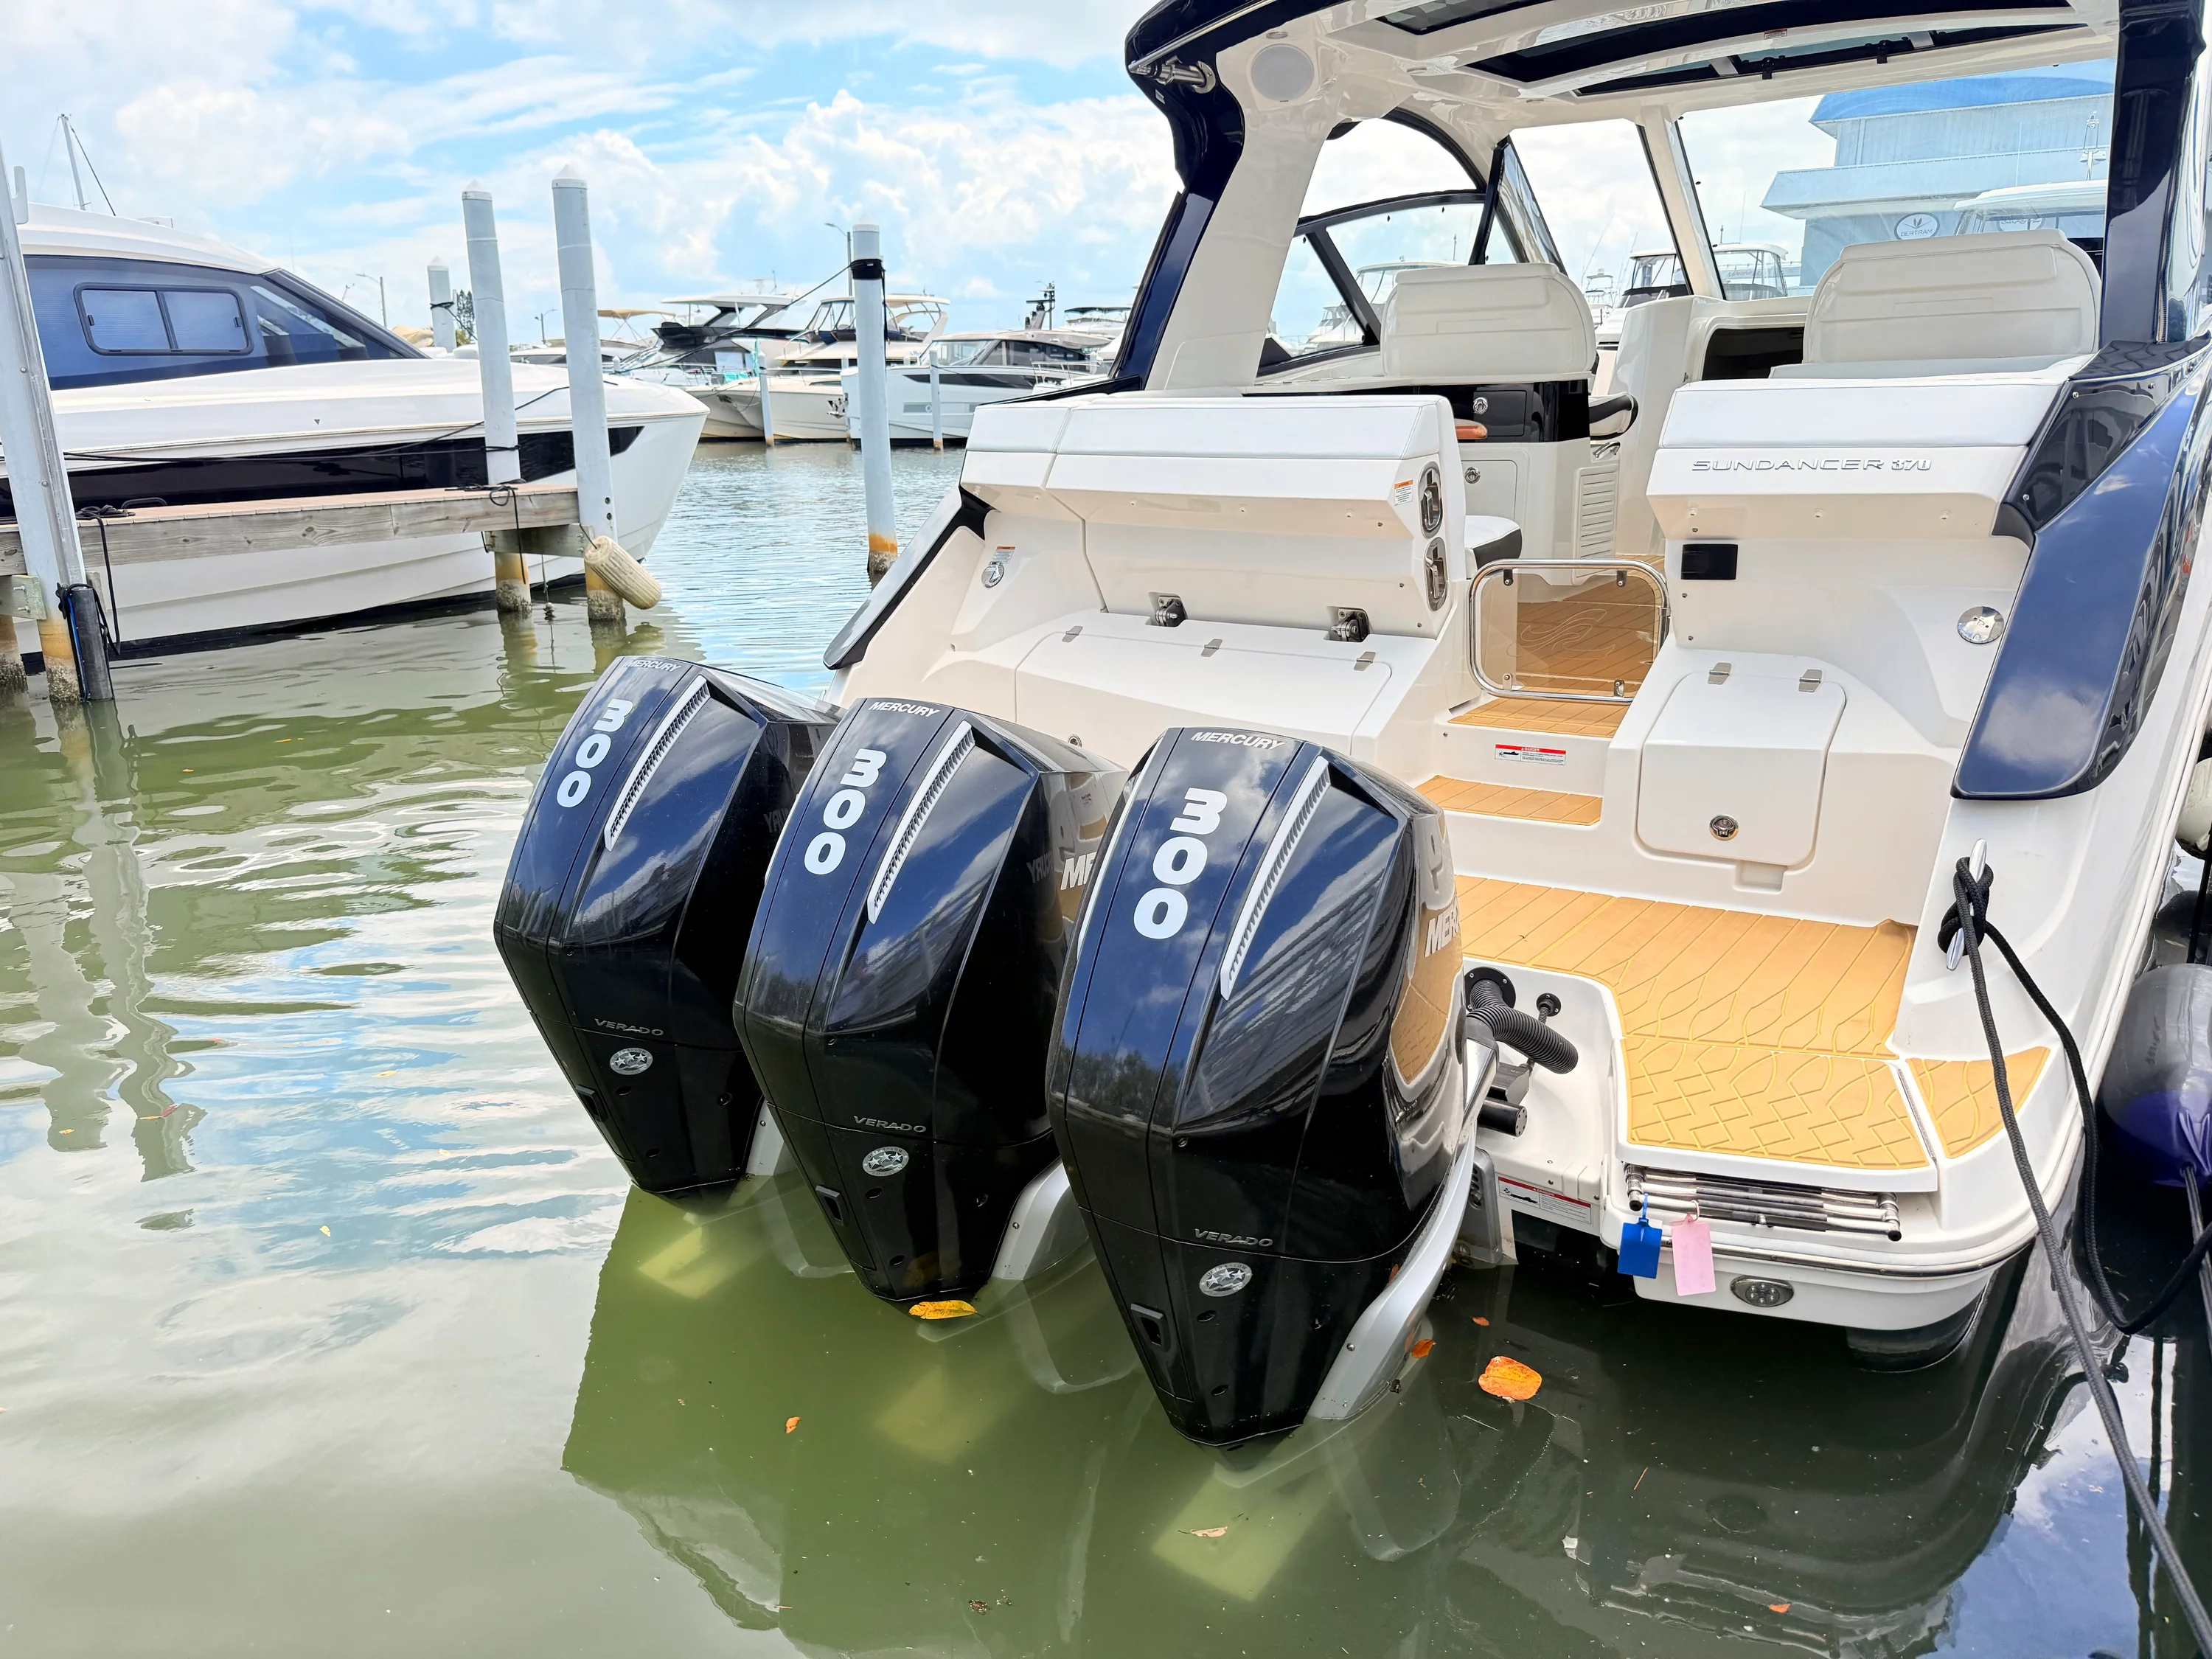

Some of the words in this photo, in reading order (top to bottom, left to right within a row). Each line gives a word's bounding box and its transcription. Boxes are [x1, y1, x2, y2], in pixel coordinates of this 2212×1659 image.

[1900, 229, 1933, 237] BERTRAM
[1691, 459, 1885, 471] SUNDANCER
[1891, 459, 1932, 471] 370
[624, 659, 682, 672] MERCURY
[868, 701, 941, 717] MERCURY
[1191, 731, 1287, 751] MERCURY
[557, 698, 634, 807] 300
[804, 748, 887, 875] 300
[1133, 787, 1228, 940] 300
[594, 1018, 664, 1036] VERADO
[853, 1116, 927, 1133] VERADO
[1194, 1228, 1273, 1247] VERADO
